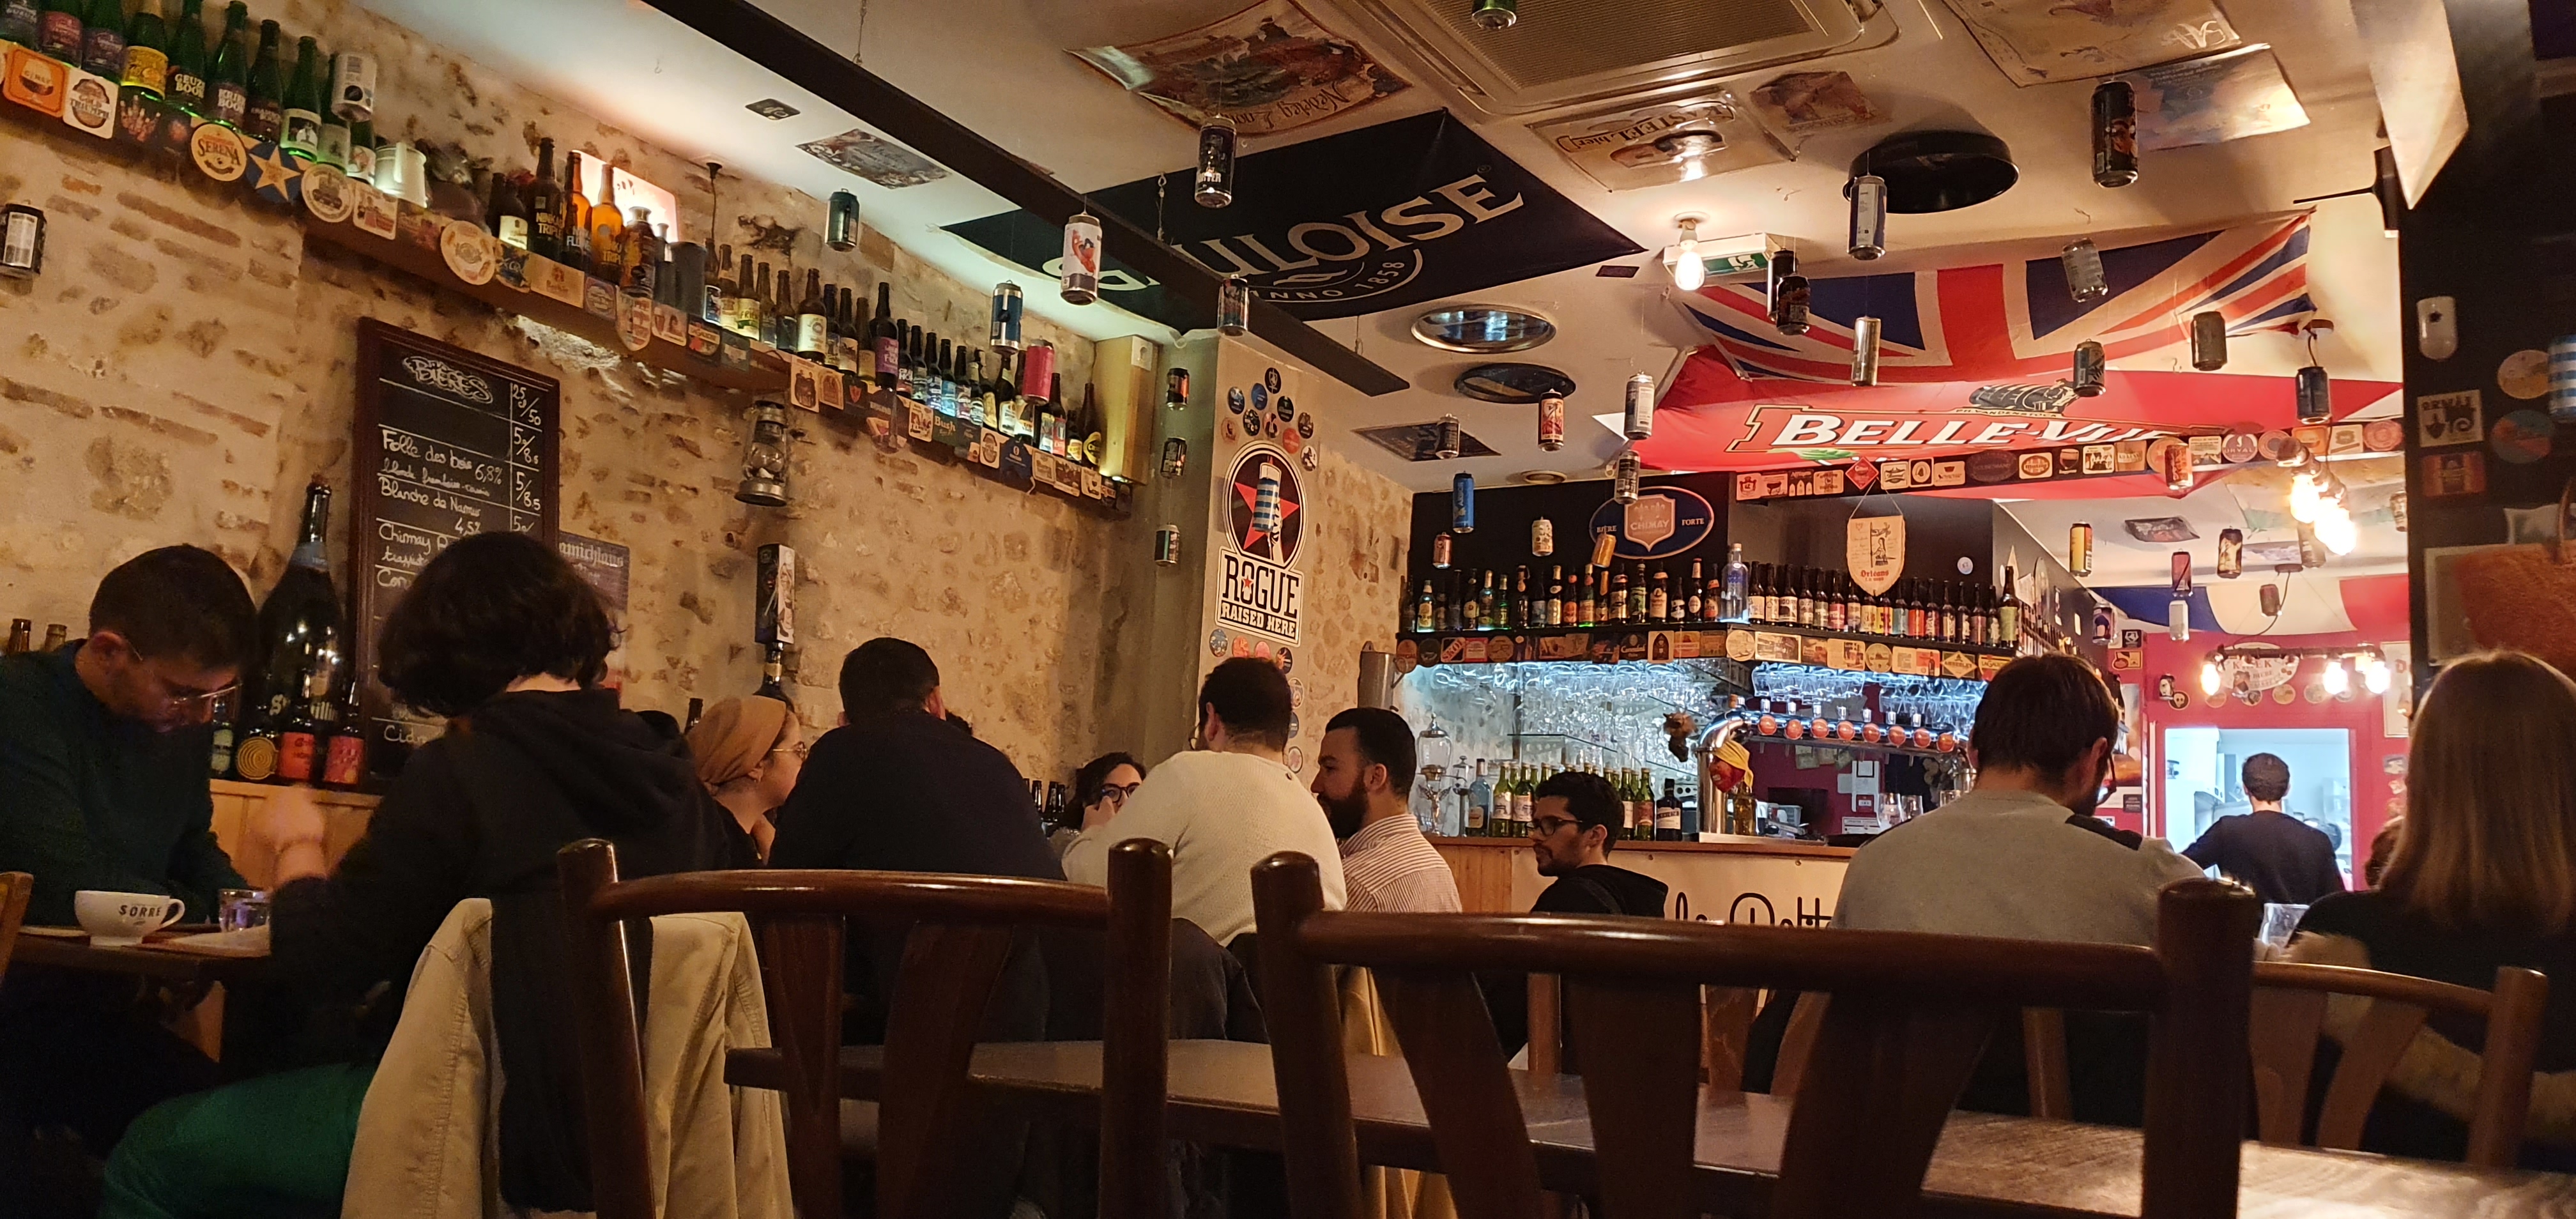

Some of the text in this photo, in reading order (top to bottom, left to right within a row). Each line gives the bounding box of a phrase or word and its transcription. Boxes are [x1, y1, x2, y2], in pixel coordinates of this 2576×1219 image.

[197, 137, 242, 166] SERENA
[1353, 261, 1407, 291] 1858
[934, 415, 956, 432] Bush
[382, 429, 421, 457] Folle
[425, 445, 447, 464] des
[475, 463, 503, 485] 6,8%
[378, 476, 429, 506] Blanche
[433, 491, 447, 509] de
[1630, 519, 1669, 531] CHIMAY
[1682, 518, 1705, 526] FORTE
[379, 523, 431, 555] Chimay
[1222, 554, 1300, 619] ROGUE
[1221, 602, 1297, 638] RAISED HERE
